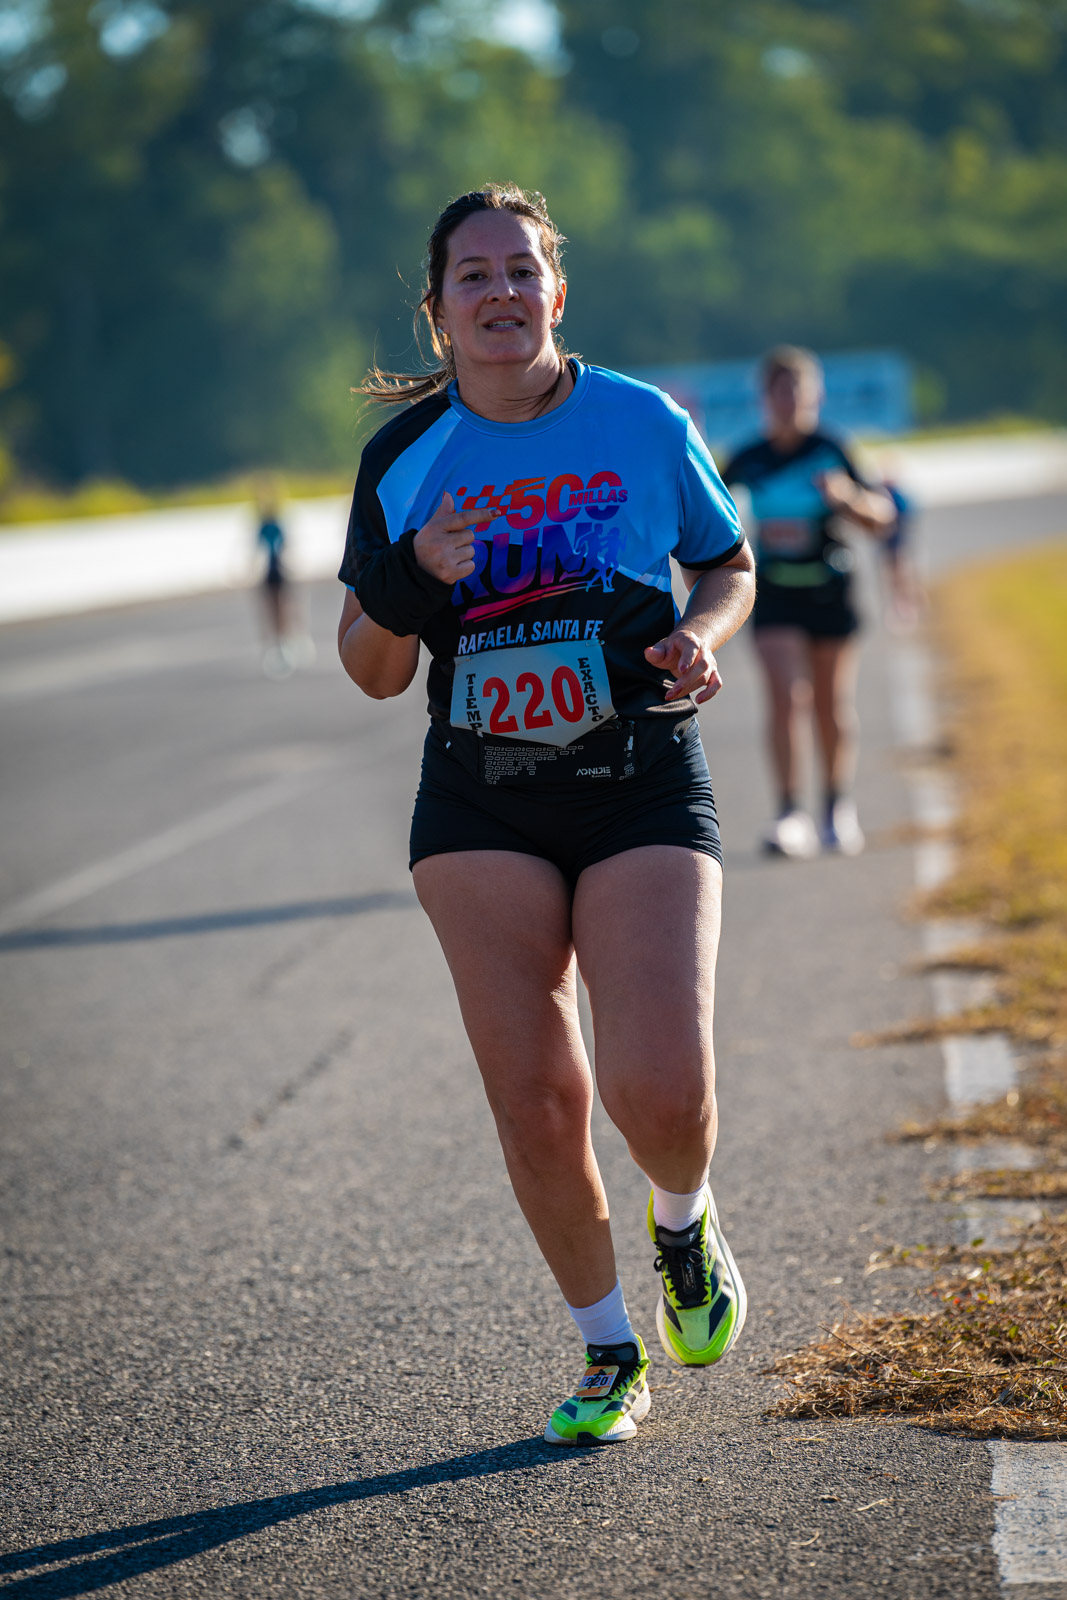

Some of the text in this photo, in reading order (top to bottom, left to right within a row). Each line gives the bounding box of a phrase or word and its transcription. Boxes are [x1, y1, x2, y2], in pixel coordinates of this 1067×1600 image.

[568, 489, 628, 507] MILLAS
[451, 522, 593, 607] RUN
[457, 619, 604, 655] RAFAELA, SANTA FE
[482, 665, 585, 734] 220
[577, 657, 604, 722] EXACTO
[584, 1376, 609, 1387] 220
